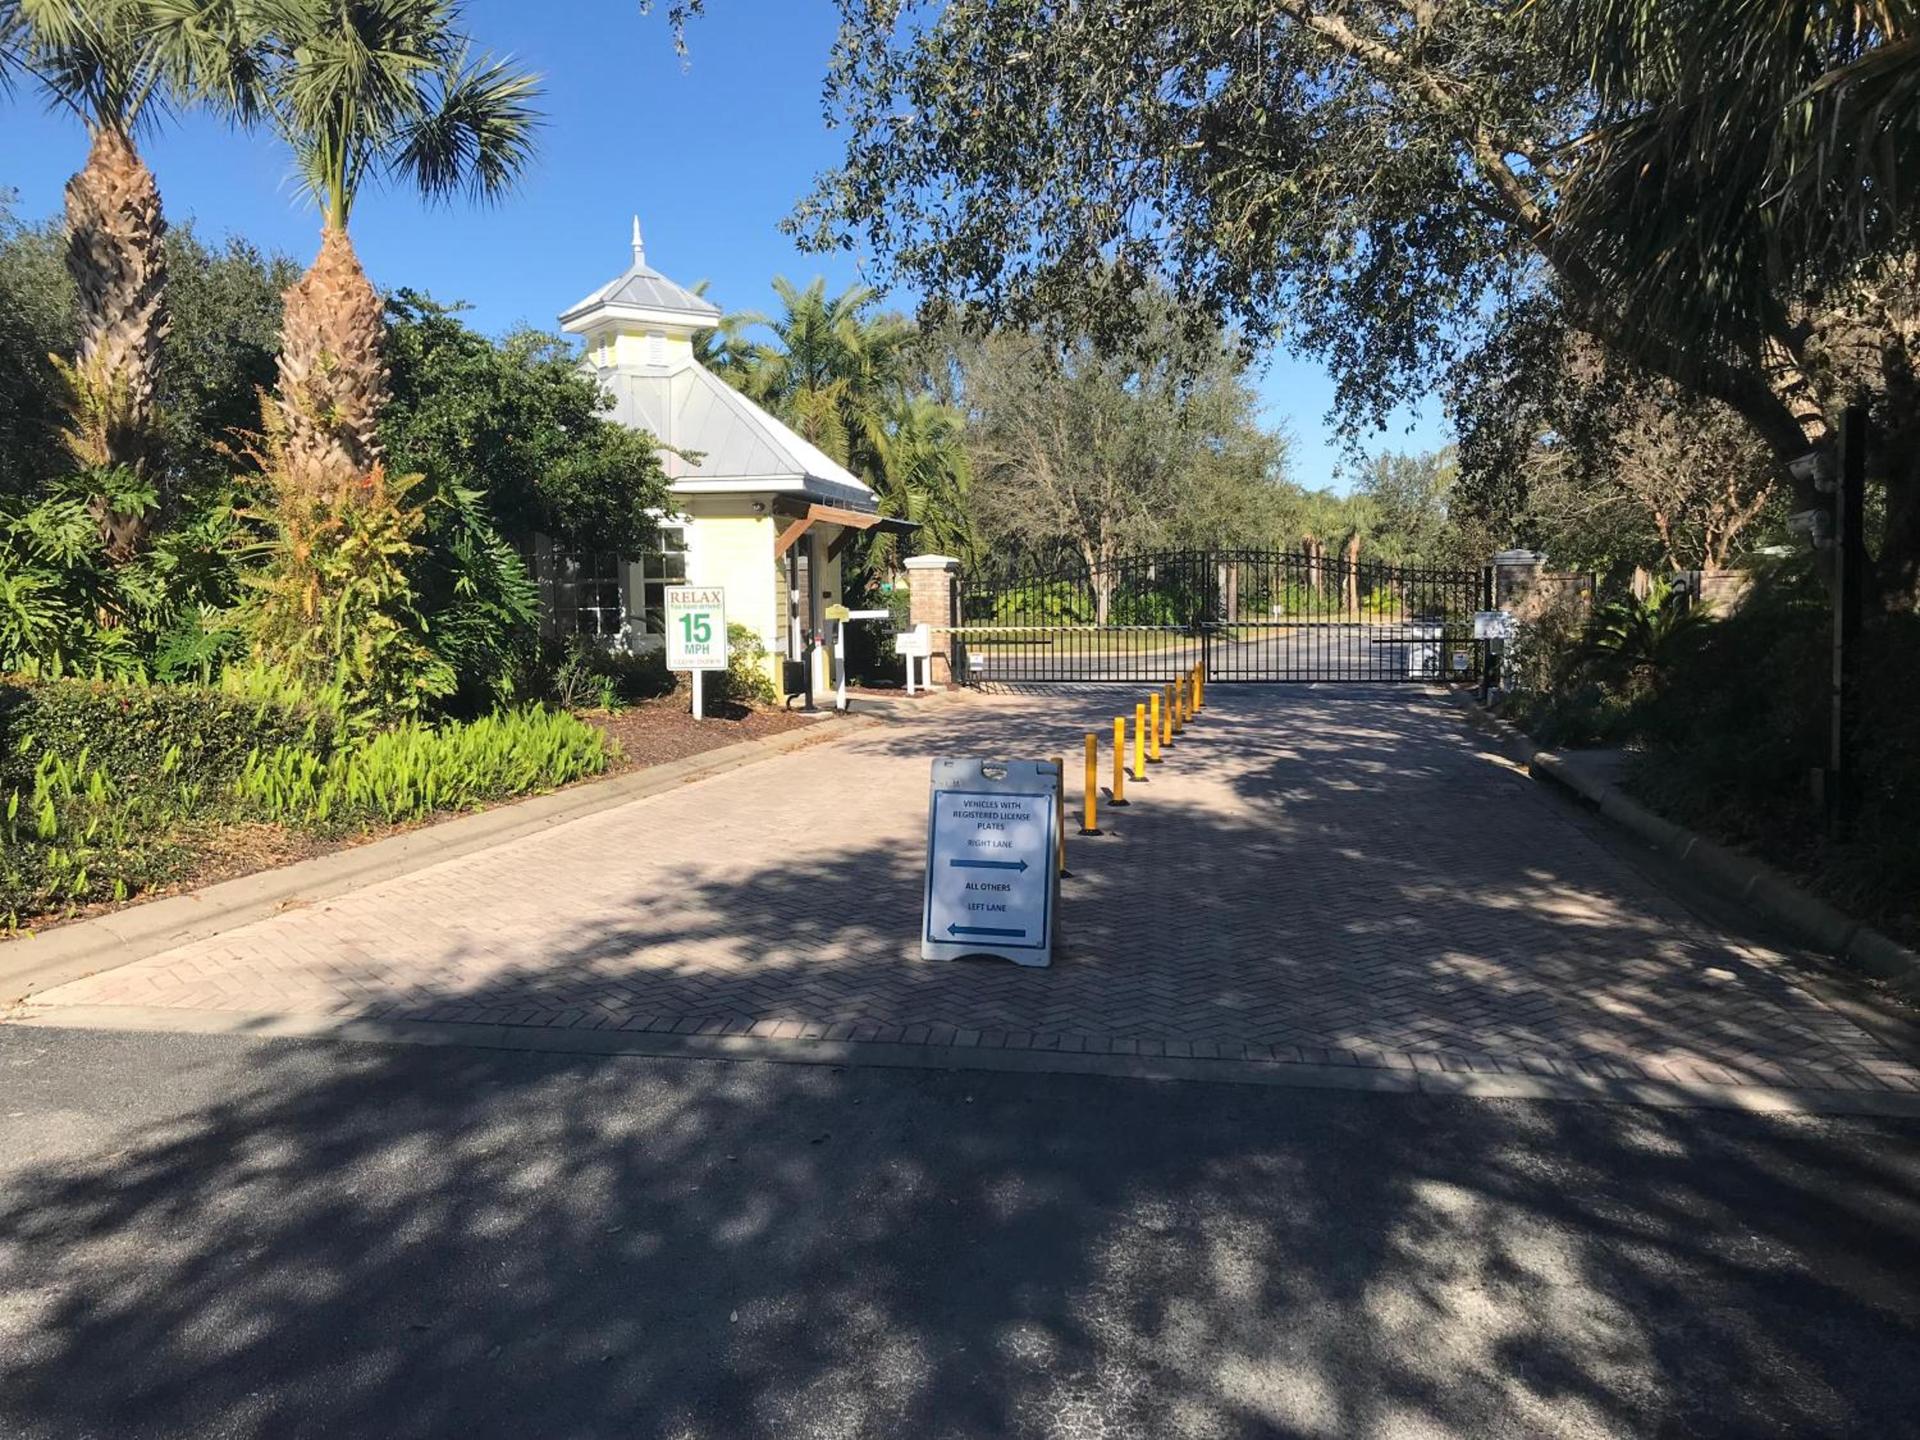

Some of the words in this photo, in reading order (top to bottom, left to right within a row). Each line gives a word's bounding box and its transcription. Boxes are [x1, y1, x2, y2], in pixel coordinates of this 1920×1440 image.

[671, 591, 721, 603] RELAX
[678, 613, 712, 643] 15
[685, 644, 710, 655] MPH
[963, 800, 998, 809] VEHICLES
[1001, 801, 1021, 810] WITH
[953, 811, 998, 820] REGISTERED
[1000, 812, 1031, 821] LICENSE
[977, 822, 1005, 831] PLATES
[967, 839, 991, 848] RIGHT
[992, 840, 1014, 849] LANE
[965, 882, 980, 891] ALL
[981, 883, 1011, 892] OTHERS
[967, 903, 985, 912] LEFT
[986, 903, 1007, 912] LANE
